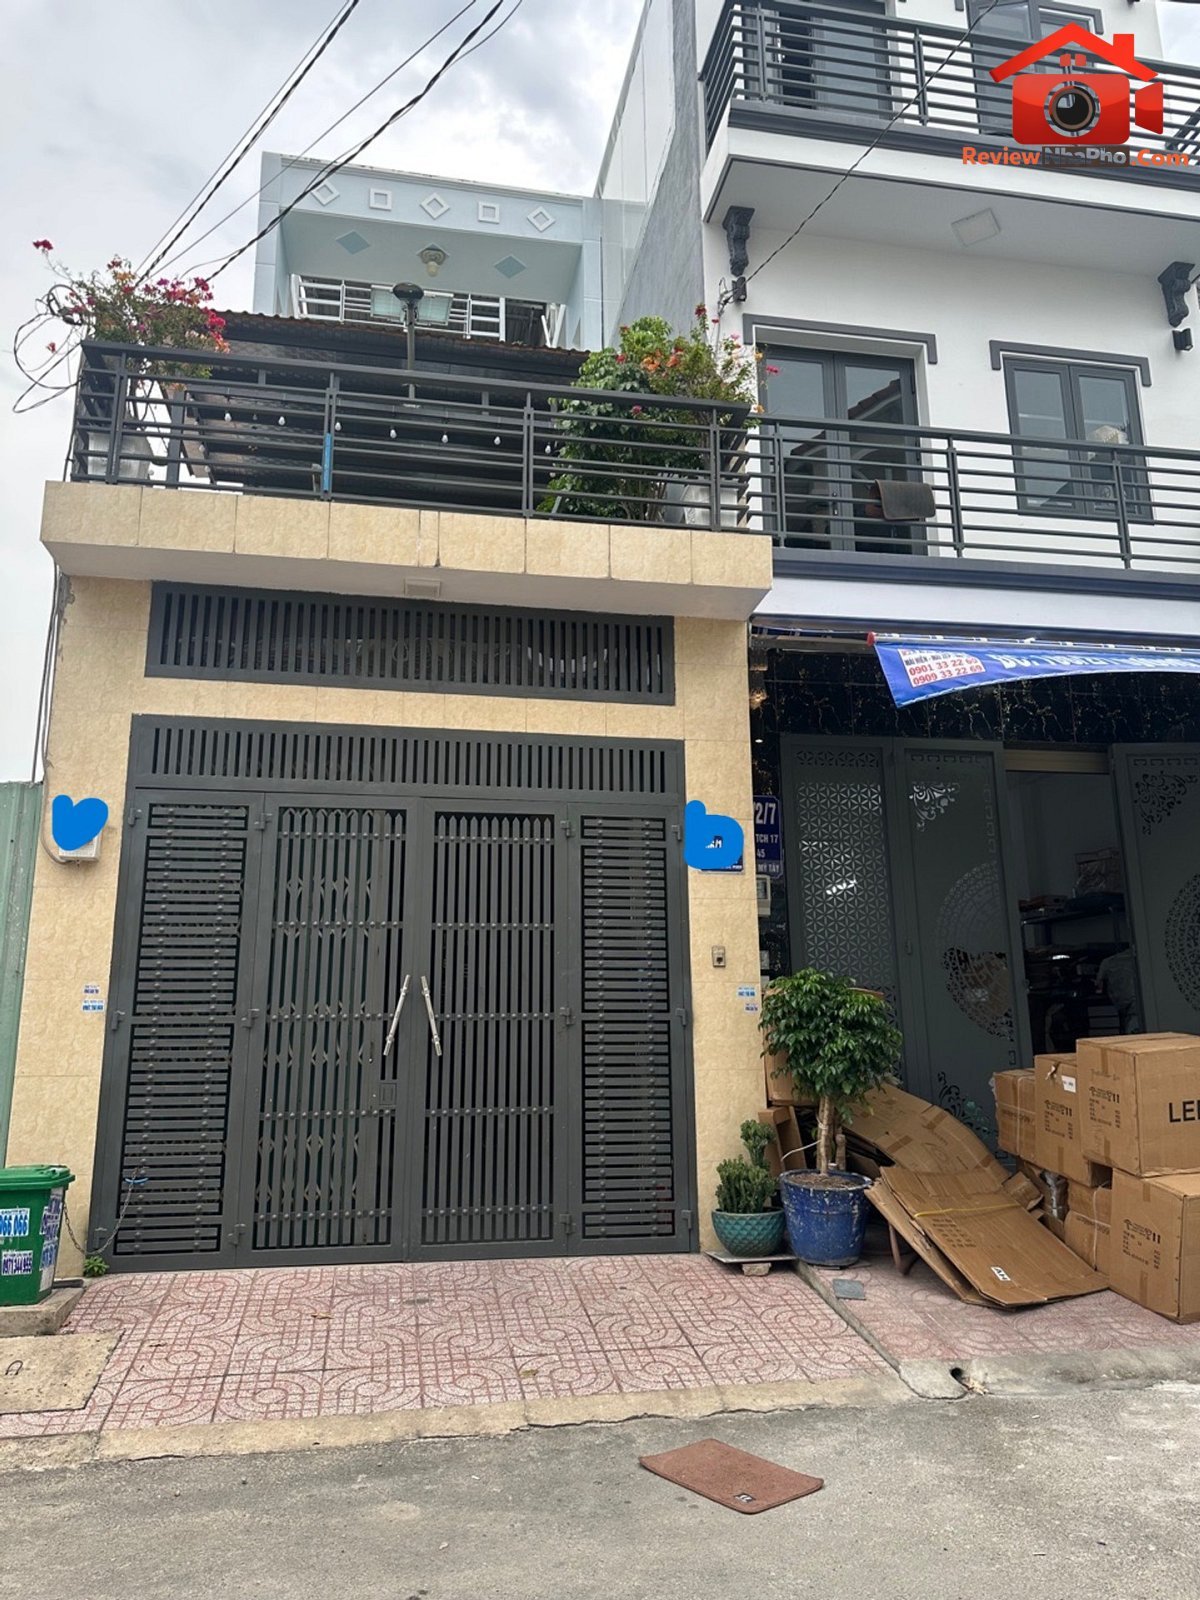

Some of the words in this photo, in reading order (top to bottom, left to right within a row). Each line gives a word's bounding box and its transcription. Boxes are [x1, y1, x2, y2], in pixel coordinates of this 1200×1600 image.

[909, 664, 933, 676] 0901
[936, 661, 949, 670] 33
[950, 659, 964, 667] 22
[912, 673, 938, 685] 0909
[940, 670, 953, 678] 33
[954, 667, 968, 675] 22
[770, 834, 779, 844] 17
